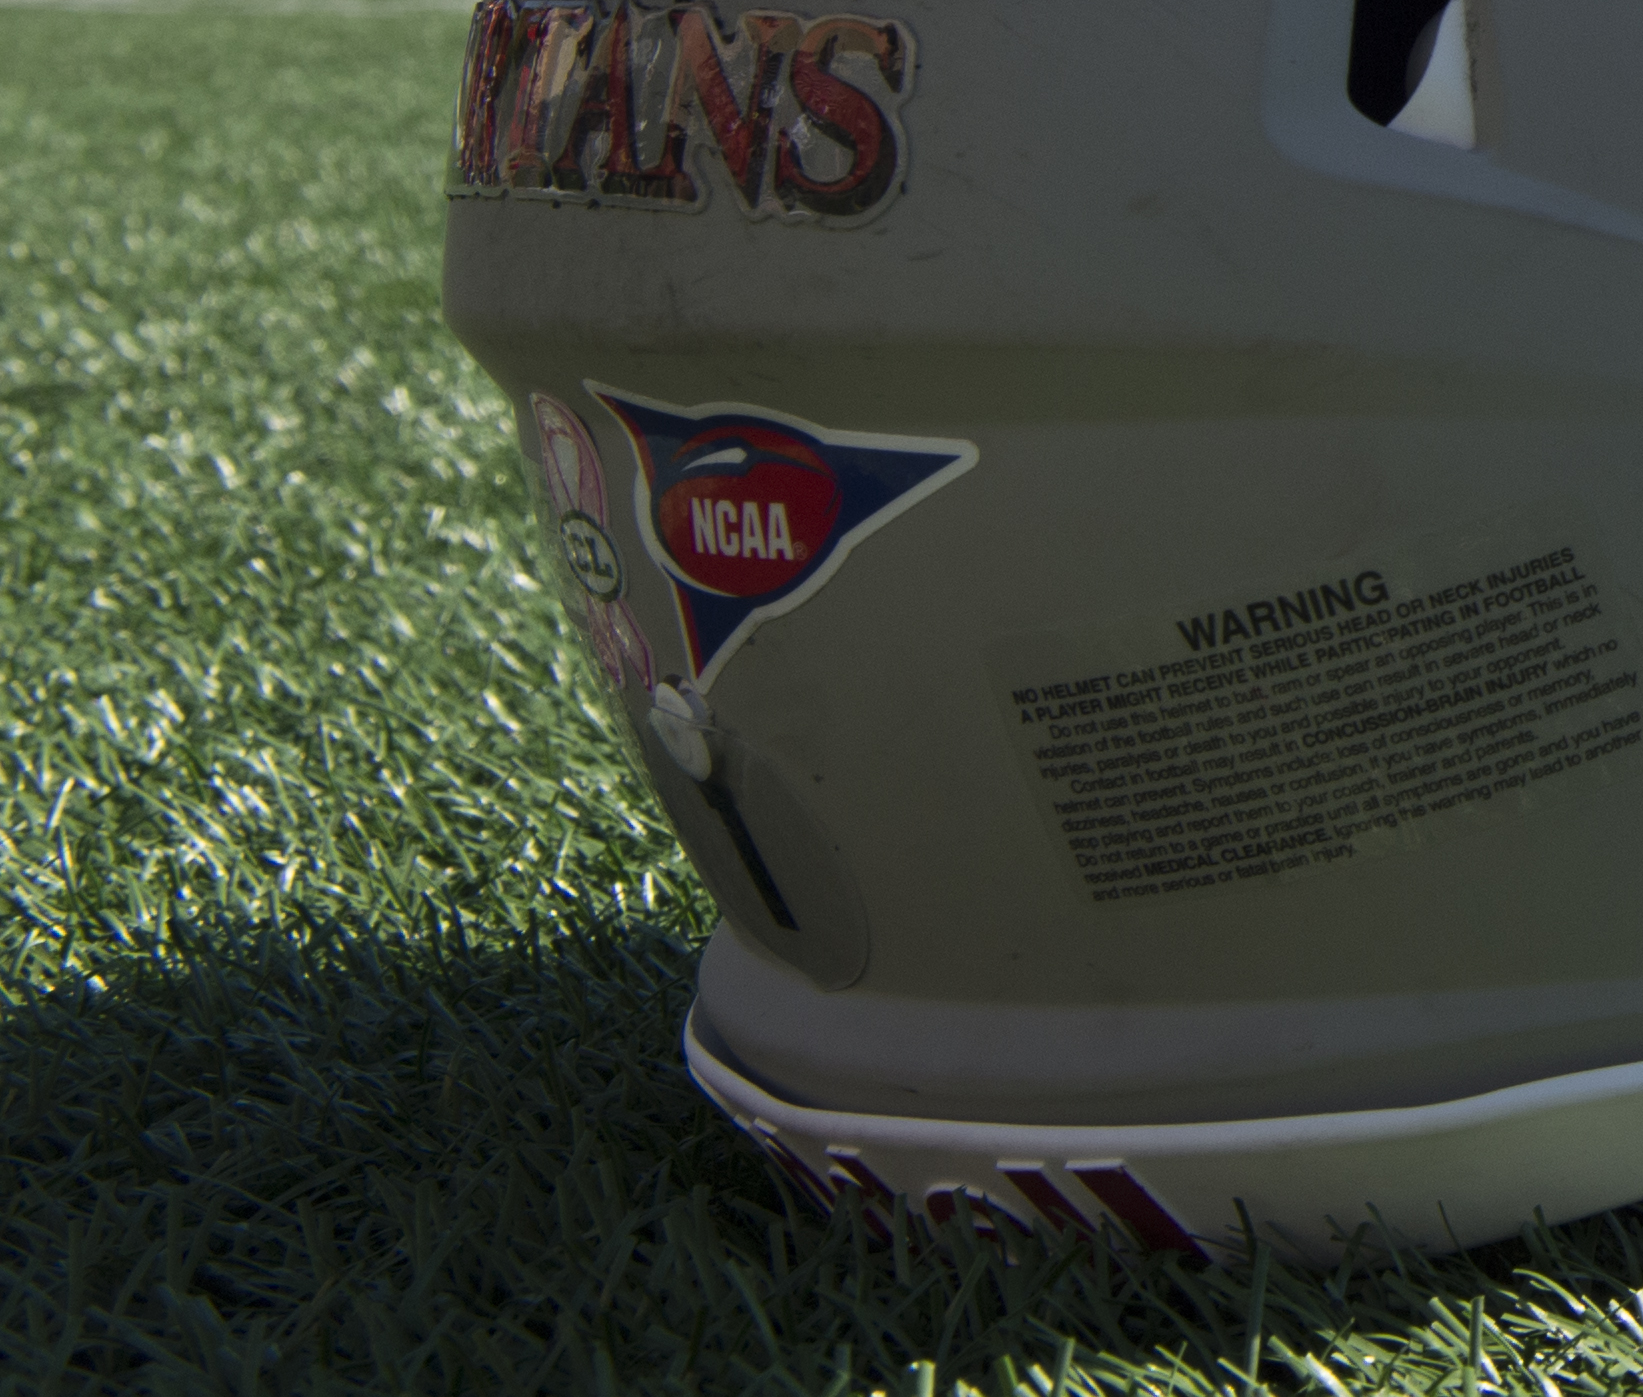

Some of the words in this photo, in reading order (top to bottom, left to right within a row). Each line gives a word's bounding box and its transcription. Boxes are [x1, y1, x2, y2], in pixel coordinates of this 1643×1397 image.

[690, 496, 794, 561] NCAA
[1011, 688, 1039, 705] NO
[1041, 675, 1111, 700] HELMET
[1115, 668, 1156, 688] CAN
[1158, 647, 1243, 680] PREVENT
[1249, 625, 1334, 659] SERIOUS
[1336, 609, 1392, 636] HEAD
[1395, 597, 1425, 619] OR
[1428, 579, 1484, 608] NECK
[1486, 547, 1574, 589] INJURIES
[1021, 709, 1034, 724] A
[1034, 698, 1103, 721] PLAYER
[1105, 686, 1162, 710] MIGHT
[1167, 668, 1248, 698] RECEIVE
[1249, 652, 1311, 679] WHILE
[1458, 601, 1480, 620] IN
[1483, 567, 1585, 612] FOOTBALL
[1034, 743, 1092, 760] violation
[1094, 736, 1109, 752] of
[1110, 735, 1136, 749] the
[1137, 722, 1193, 744] football
[1195, 716, 1234, 732] rules
[1237, 705, 1267, 724] and
[1269, 696, 1307, 716] such
[1311, 688, 1341, 706] use
[1343, 679, 1374, 697] can
[1377, 663, 1421, 686] result
[1424, 660, 1440, 673] in
[1498, 623, 1539, 648] head
[1542, 618, 1558, 633] or
[1562, 603, 1601, 626] neck
[1048, 724, 1072, 740] Do
[1073, 720, 1098, 735] not
[1100, 716, 1128, 731] use
[1129, 711, 1158, 726] this
[1159, 698, 1213, 720] helmet
[1214, 696, 1231, 708] to
[1271, 678, 1303, 694] ram
[1305, 673, 1321, 687] or
[1326, 659, 1369, 682] spear
[1374, 652, 1395, 668] an
[1399, 628, 1473, 660] opposing
[1527, 598, 1563, 616] This
[1565, 591, 1580, 604] is
[1582, 584, 1597, 598] in
[1177, 571, 1389, 650] WARNING
[1053, 797, 1102, 814] helmet
[1103, 794, 1130, 808] can
[1192, 766, 1274, 793] Symptoms
[1336, 742, 1369, 759] loss
[1371, 733, 1387, 750] of
[1390, 700, 1505, 744] consciousness
[1507, 693, 1523, 707] or
[1070, 771, 1127, 794] Contact
[1129, 770, 1145, 785] in
[1145, 760, 1200, 781] football
[1202, 755, 1235, 771] may
[1238, 741, 1282, 762] result
[1284, 740, 1300, 752] in
[1302, 685, 1482, 747] CONCUSSION-BRAIN
[1484, 661, 1548, 694] INJURY
[1553, 646, 1596, 670] which
[1597, 639, 1618, 654] no
[1096, 750, 1162, 773] paralysis
[1163, 746, 1179, 759] or
[1183, 735, 1227, 756] death
[1228, 733, 1246, 745] to
[1247, 725, 1278, 745] you
[1280, 714, 1311, 734] and
[1313, 698, 1378, 728] possible
[1383, 685, 1424, 706] injury
[1427, 678, 1445, 692] to
[1447, 666, 1481, 690] your
[1211, 787, 1268, 807] nausea
[1270, 782, 1285, 795] or
[1368, 755, 1380, 769] If
[1382, 751, 1412, 770] you
[1414, 737, 1453, 756] have
[1544, 672, 1637, 715] immediately
[1068, 836, 1099, 855] stop
[1101, 829, 1154, 848] playing
[1155, 821, 1184, 838] and
[1186, 812, 1232, 832] report
[1233, 805, 1273, 823] them
[1274, 801, 1291, 813] to
[1297, 792, 1327, 813] your
[1386, 761, 1436, 784] trainer
[1441, 748, 1472, 769] and
[1075, 853, 1098, 868] Do
[1099, 845, 1123, 863] not
[1125, 845, 1168, 860] return
[1168, 842, 1185, 854] to
[1187, 839, 1199, 851] a
[1200, 831, 1244, 852] game
[1245, 827, 1261, 839] or
[1264, 809, 1324, 838] practice
[1326, 801, 1359, 821] until
[1363, 794, 1380, 812] all
[1383, 774, 1463, 807] symptoms
[1466, 764, 1492, 781] are
[1495, 750, 1535, 775] gone
[1538, 736, 1569, 758] and
[1570, 726, 1601, 748] you
[1601, 711, 1640, 733] have
[1084, 865, 1143, 884] received
[1143, 849, 1219, 876] MEDICAL
[1333, 812, 1398, 840] Ignoring
[1395, 797, 1427, 820] this
[1428, 785, 1492, 811] warning
[1493, 773, 1526, 792] may
[1529, 758, 1564, 780] lead
[1565, 751, 1582, 768] to
[1585, 730, 1641, 760] another
[1092, 886, 1120, 902] and
[1121, 883, 1159, 897] more
[1161, 874, 1216, 892] serious
[1217, 870, 1233, 883] or
[1235, 861, 1269, 878] fatal
[1268, 854, 1309, 873] brain
